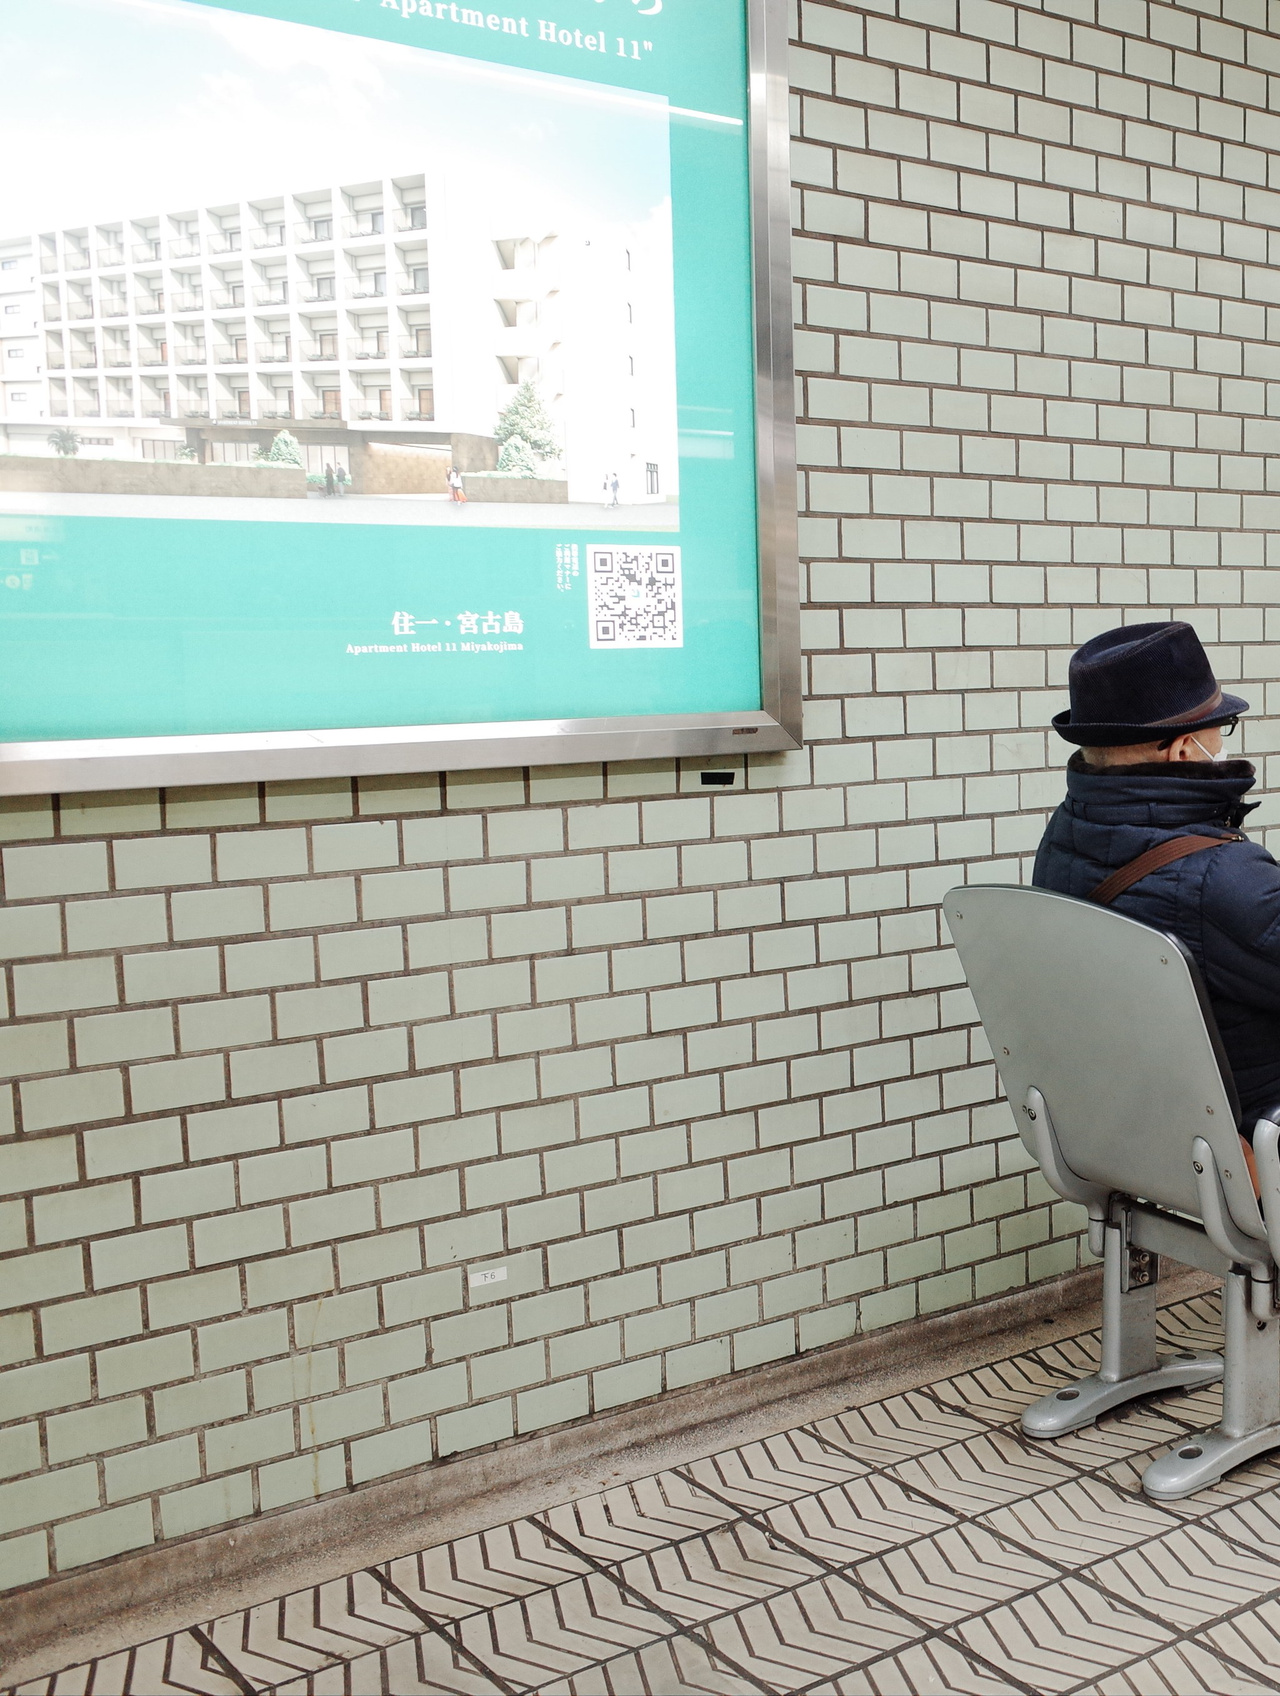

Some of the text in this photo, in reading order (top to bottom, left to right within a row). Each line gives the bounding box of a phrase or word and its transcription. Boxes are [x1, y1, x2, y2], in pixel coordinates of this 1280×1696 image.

[538, 19, 607, 53] Hotel
[391, 611, 525, 636] 住一・宮古島
[346, 641, 524, 655] Apartment Hotel 11 Miyakojima
